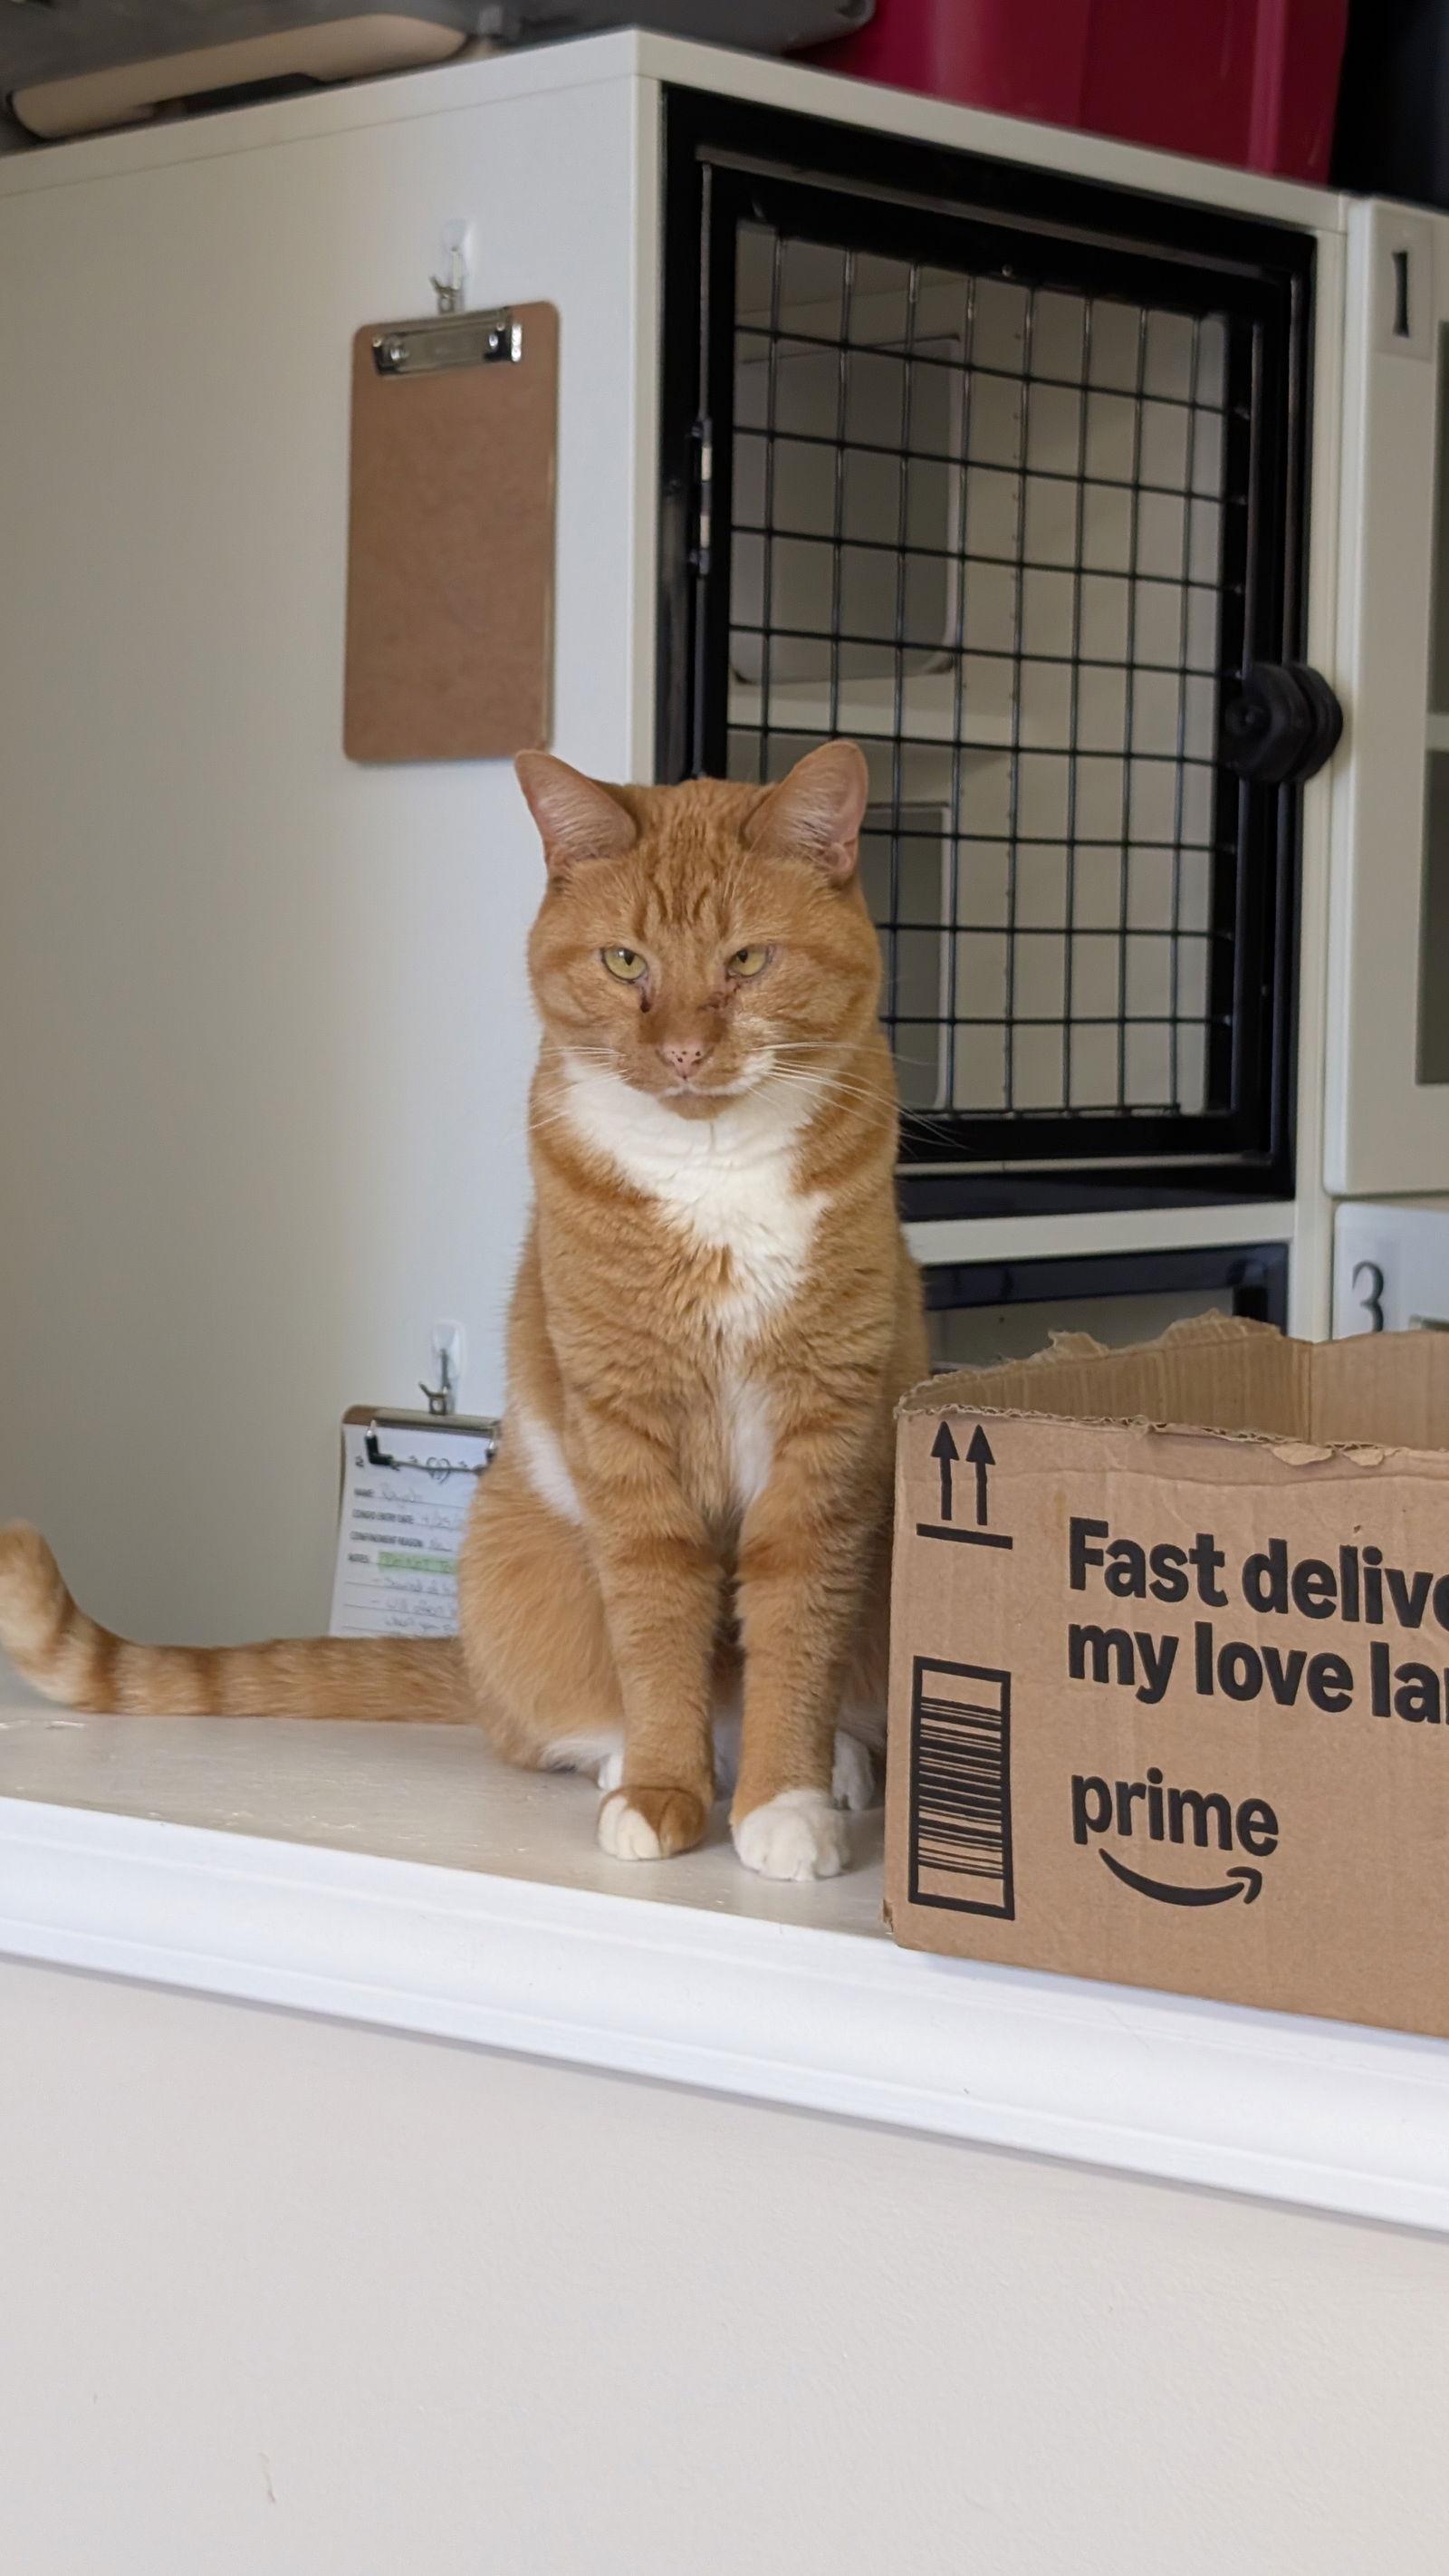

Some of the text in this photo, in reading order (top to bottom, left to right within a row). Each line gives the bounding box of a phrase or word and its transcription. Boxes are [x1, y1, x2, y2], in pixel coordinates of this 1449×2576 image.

[1352, 1260, 1385, 1332] 3
[1070, 1516, 1229, 1608] Fast
[1068, 1620, 1449, 1726] my love la
[1071, 1767, 1280, 1857] prime
